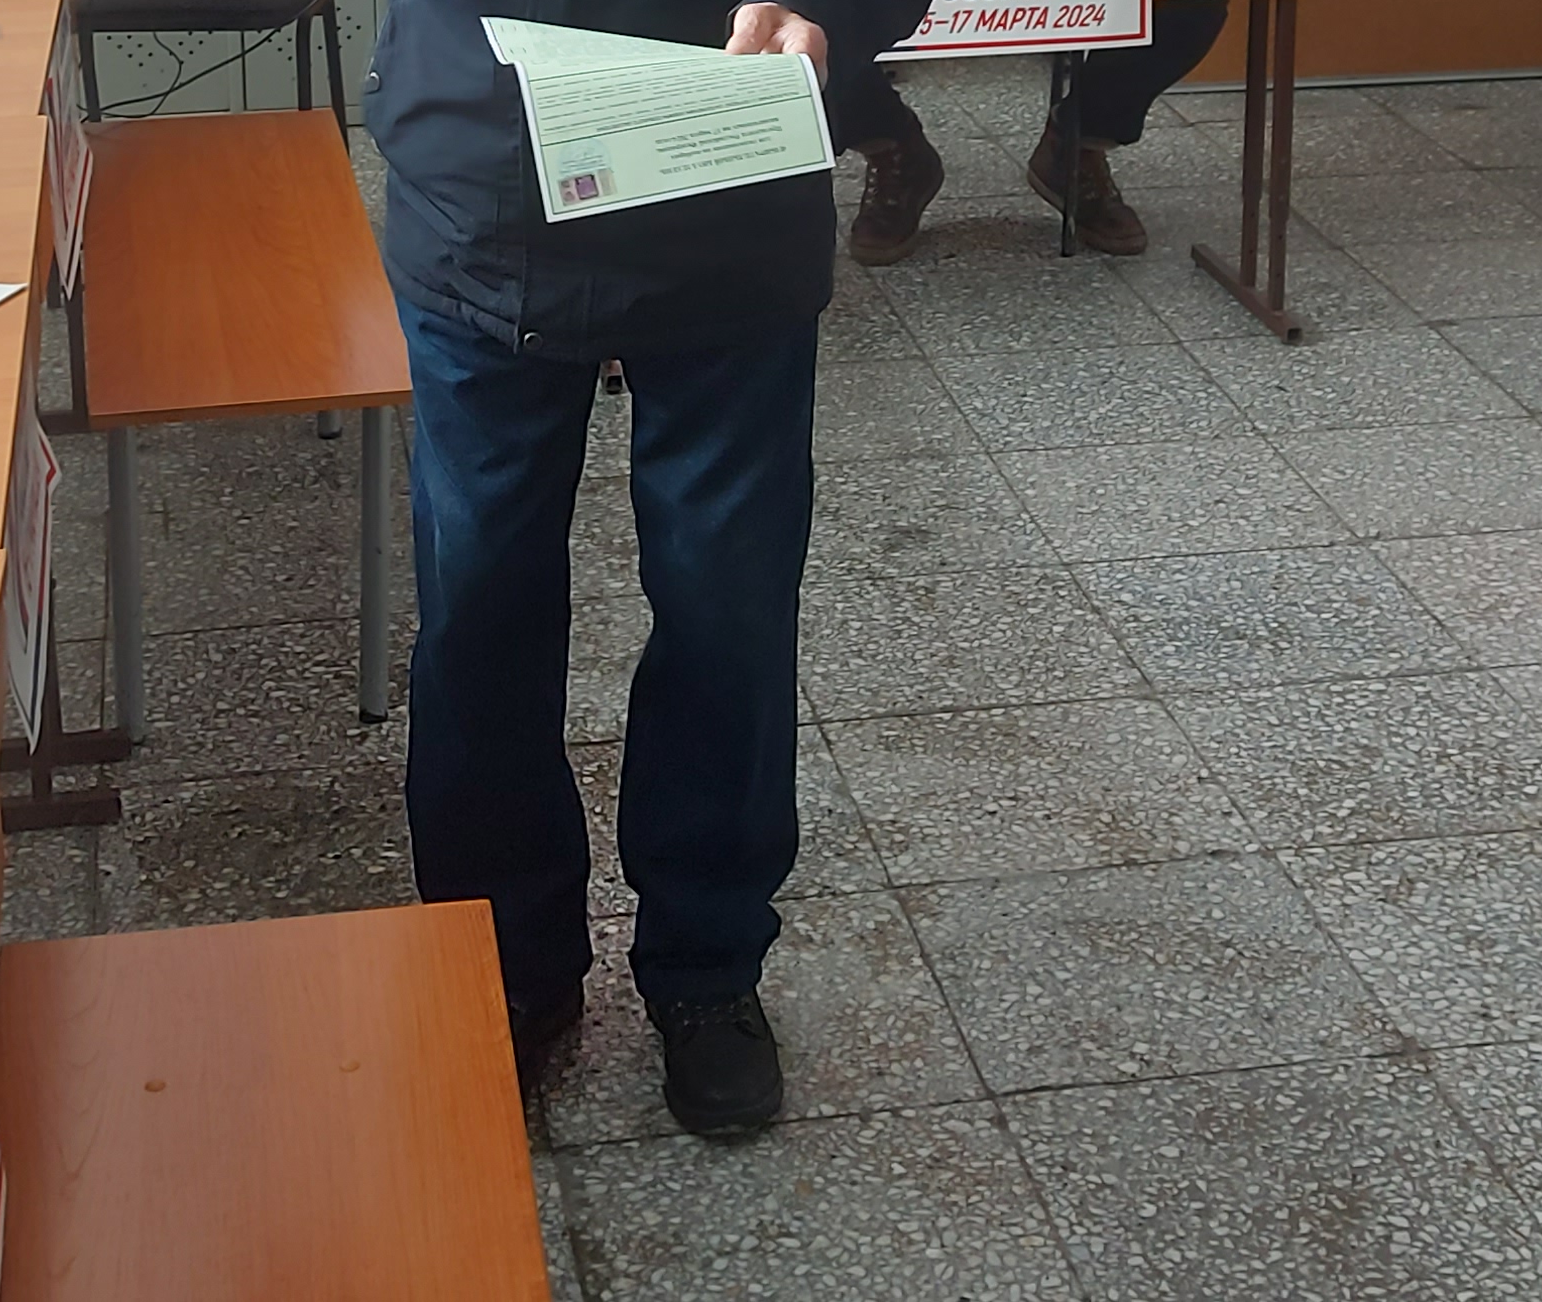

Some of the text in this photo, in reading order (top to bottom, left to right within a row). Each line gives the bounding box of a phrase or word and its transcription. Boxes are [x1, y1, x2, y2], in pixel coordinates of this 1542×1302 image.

[919, 3, 1107, 36] 5–17 МАРТА 2024
